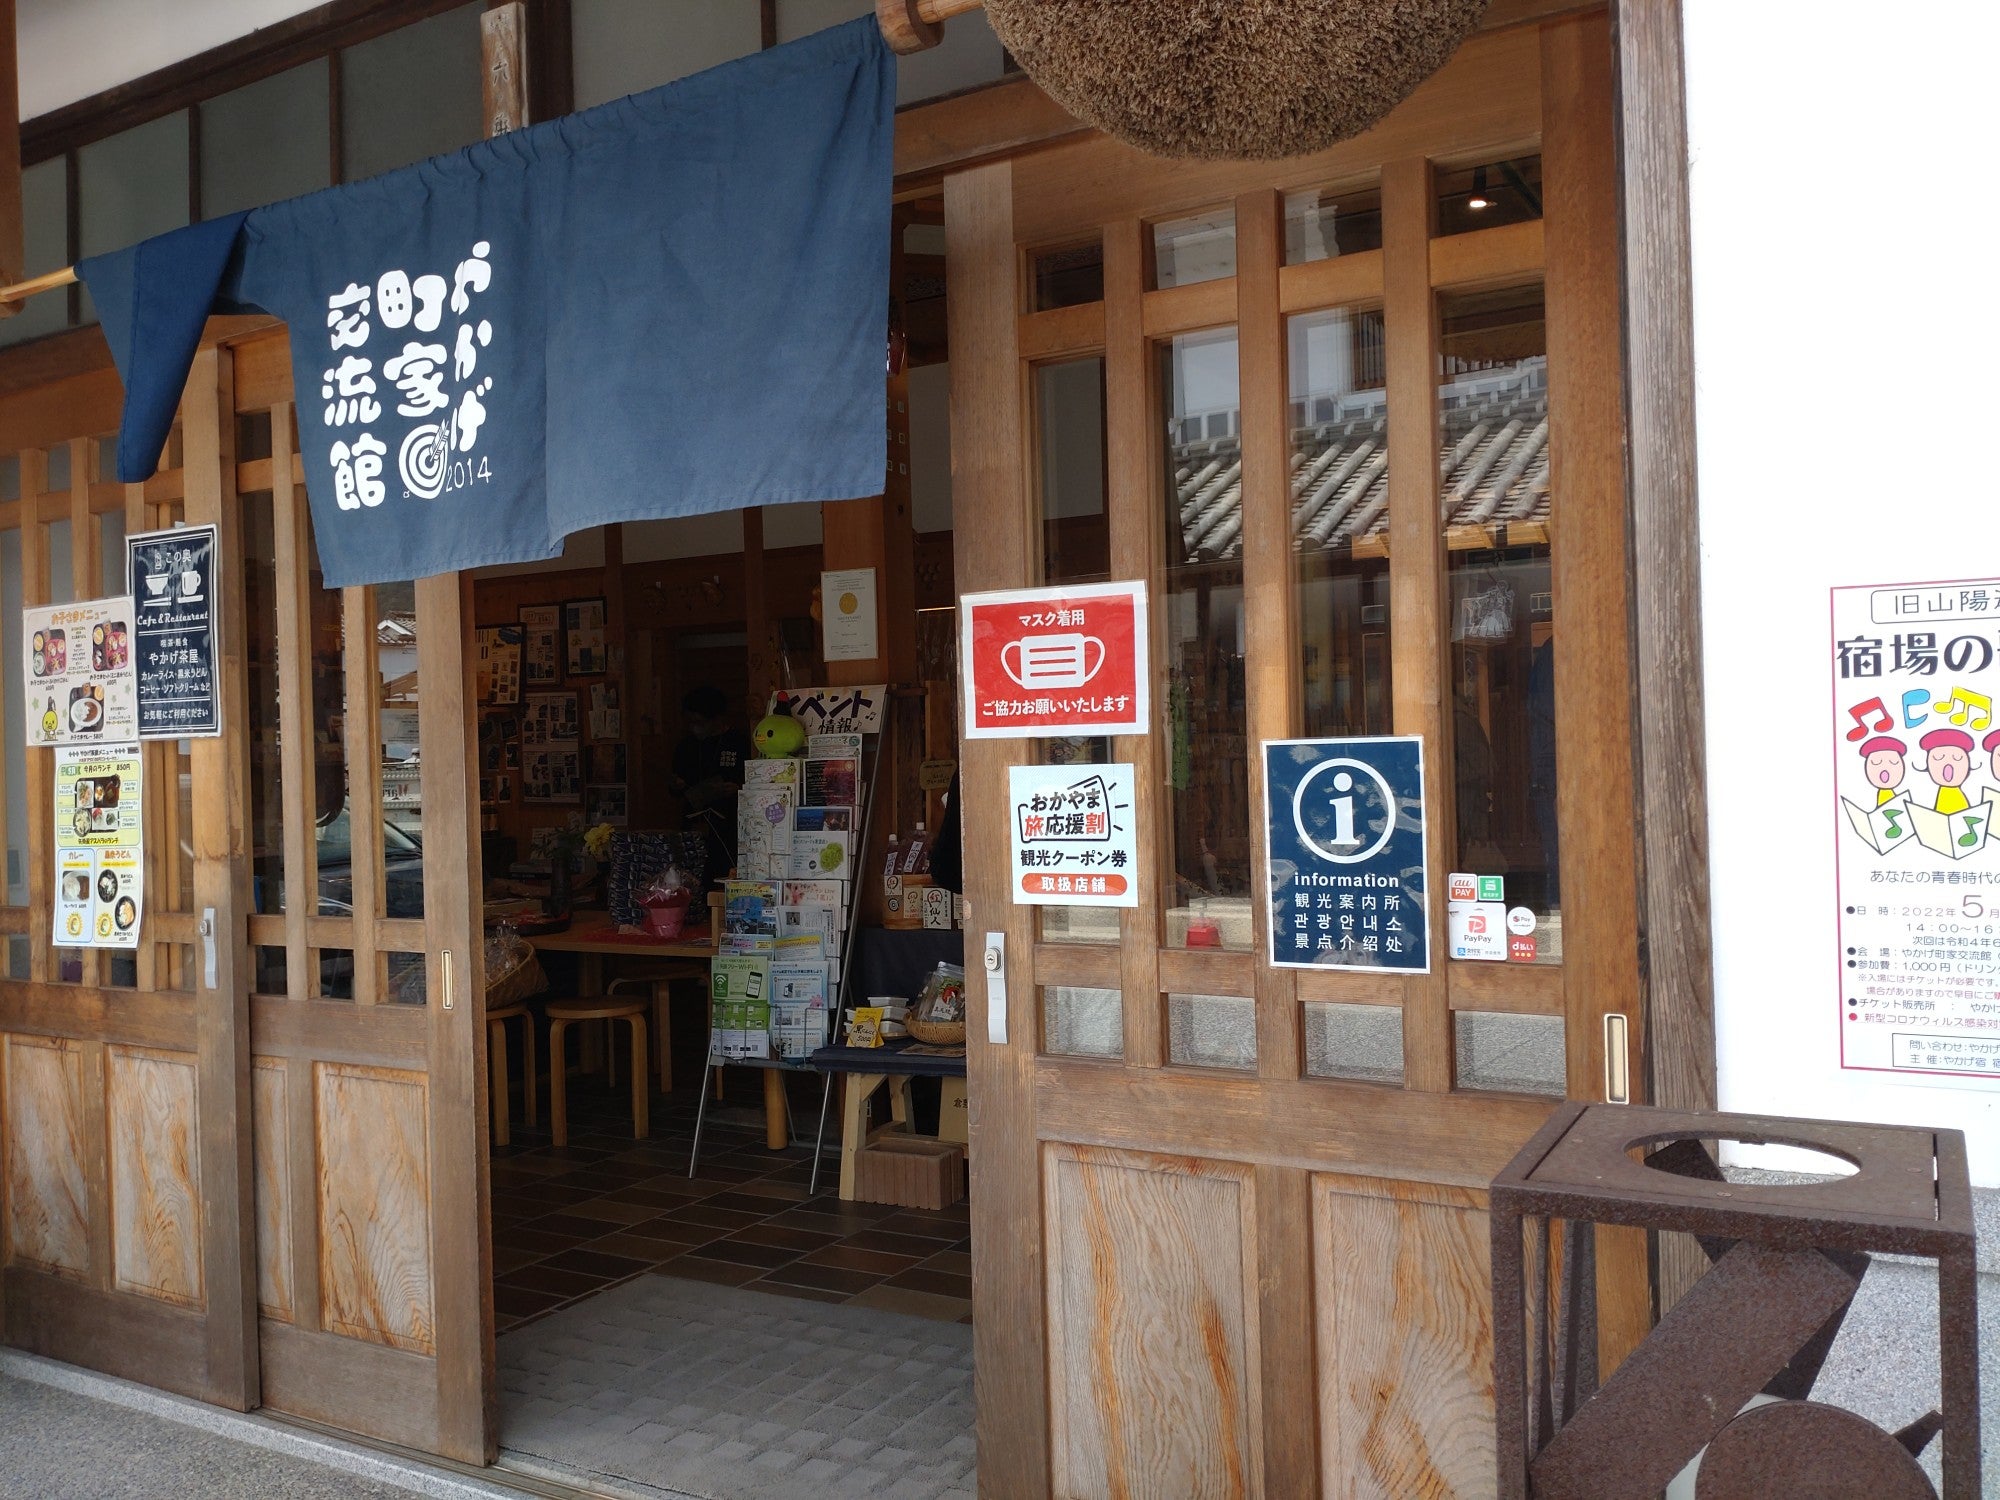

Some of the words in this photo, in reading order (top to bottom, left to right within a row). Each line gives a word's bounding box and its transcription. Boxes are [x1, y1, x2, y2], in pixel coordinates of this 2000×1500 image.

[445, 455, 493, 493] 2014
[1018, 609, 1085, 627] マスク着用
[148, 648, 199, 666] やかげ茶屋
[1837, 629, 2000, 679] 宿場の
[790, 690, 872, 719] ベント
[981, 694, 1130, 718] ご協力お願いいたします
[818, 716, 852, 734] 情報
[1030, 788, 1101, 812] おかやま
[1023, 811, 1106, 837] 旅応援割
[1020, 849, 1128, 868] 観光クーポン券
[1041, 876, 1107, 894] 取扱店舗
[1293, 872, 1400, 889] information
[1294, 892, 1401, 912] 観光案内所
[1455, 888, 1472, 898] PAY
[1294, 912, 1403, 932] 관광안내소
[1294, 935, 1404, 953] 景点介绍处
[1463, 935, 1493, 944] PayPay
[1864, 1013, 2000, 1028] 新型コロナウィルス感染対
